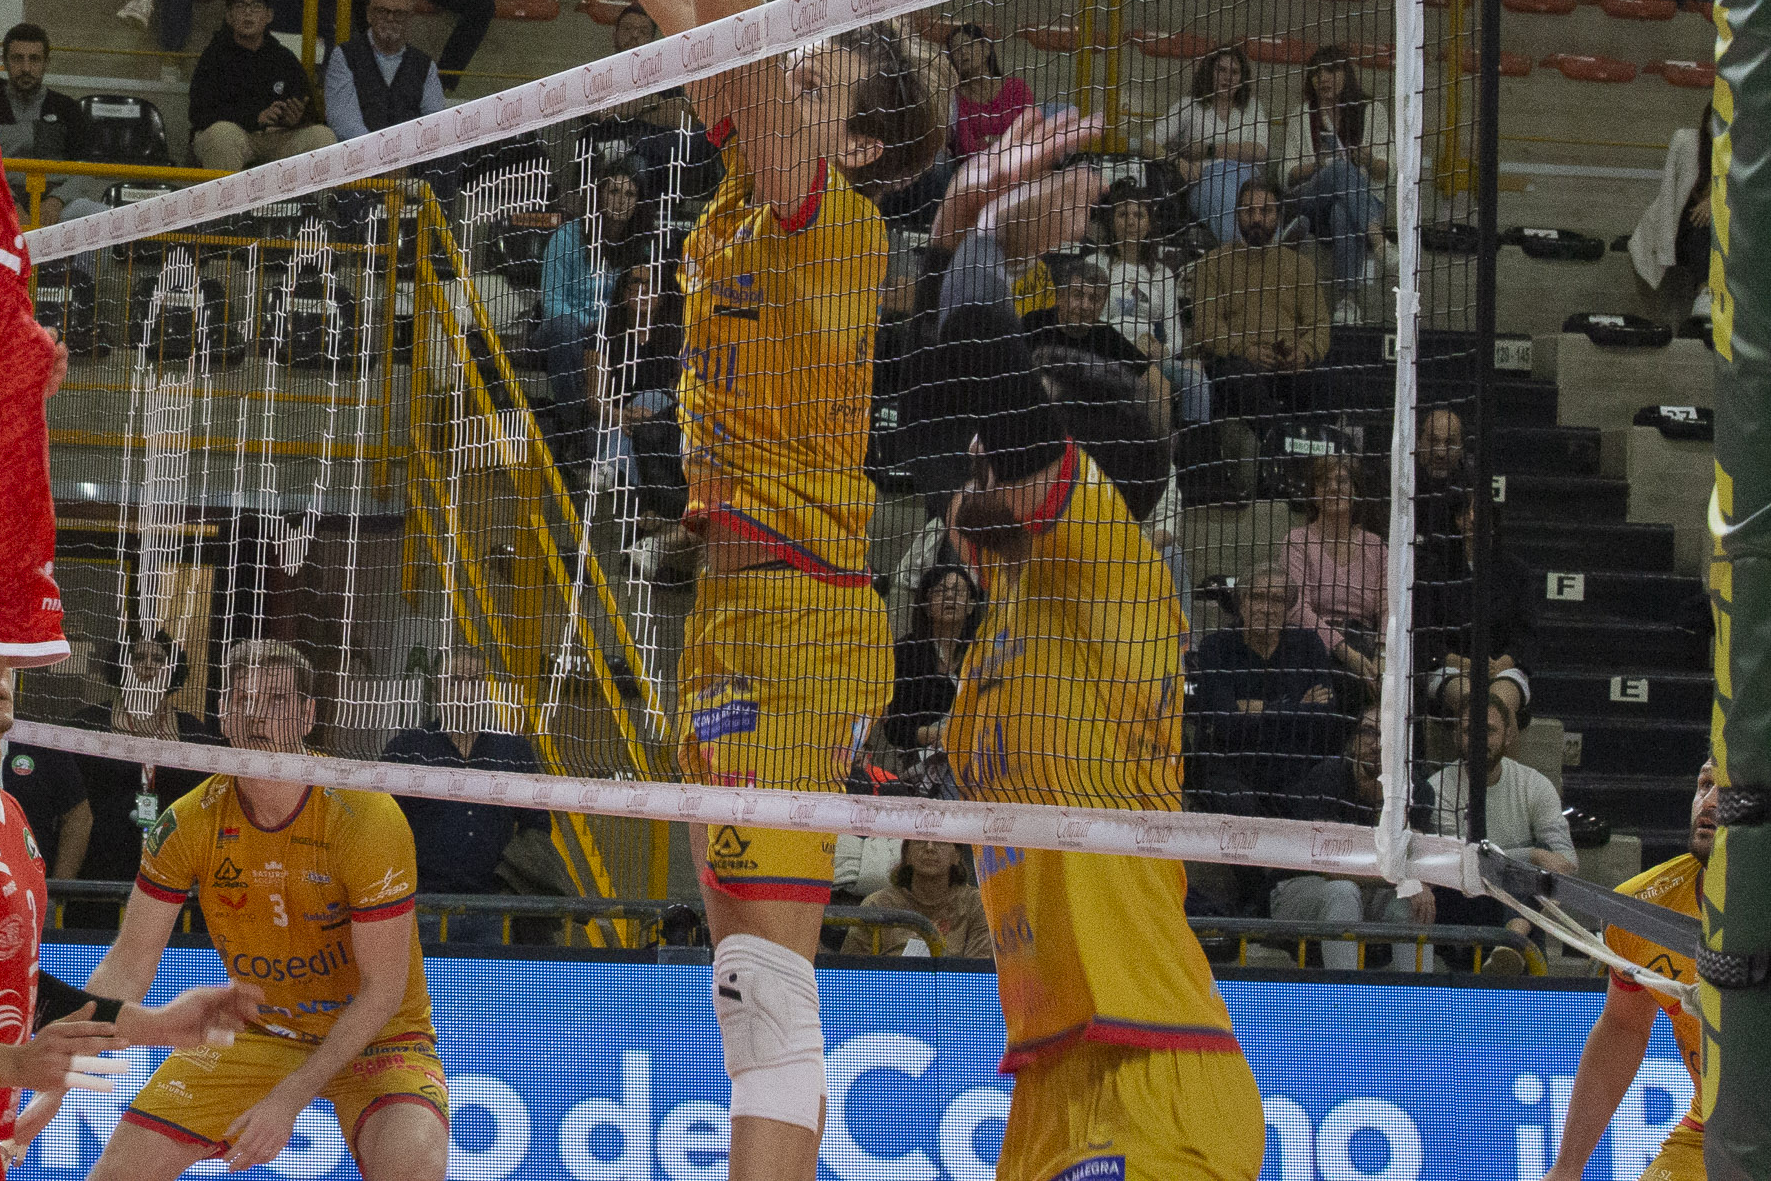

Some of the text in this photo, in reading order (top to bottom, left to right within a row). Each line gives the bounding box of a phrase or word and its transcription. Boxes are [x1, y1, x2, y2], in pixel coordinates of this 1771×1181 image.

[732, 10, 771, 52] Torquti
[680, 29, 716, 69] Torquati
[1556, 576, 1576, 596] F
[1620, 677, 1640, 699] E
[269, 893, 289, 928] 3
[233, 941, 349, 982] cosedil
[157, 1080, 194, 1100] SATURNIA
